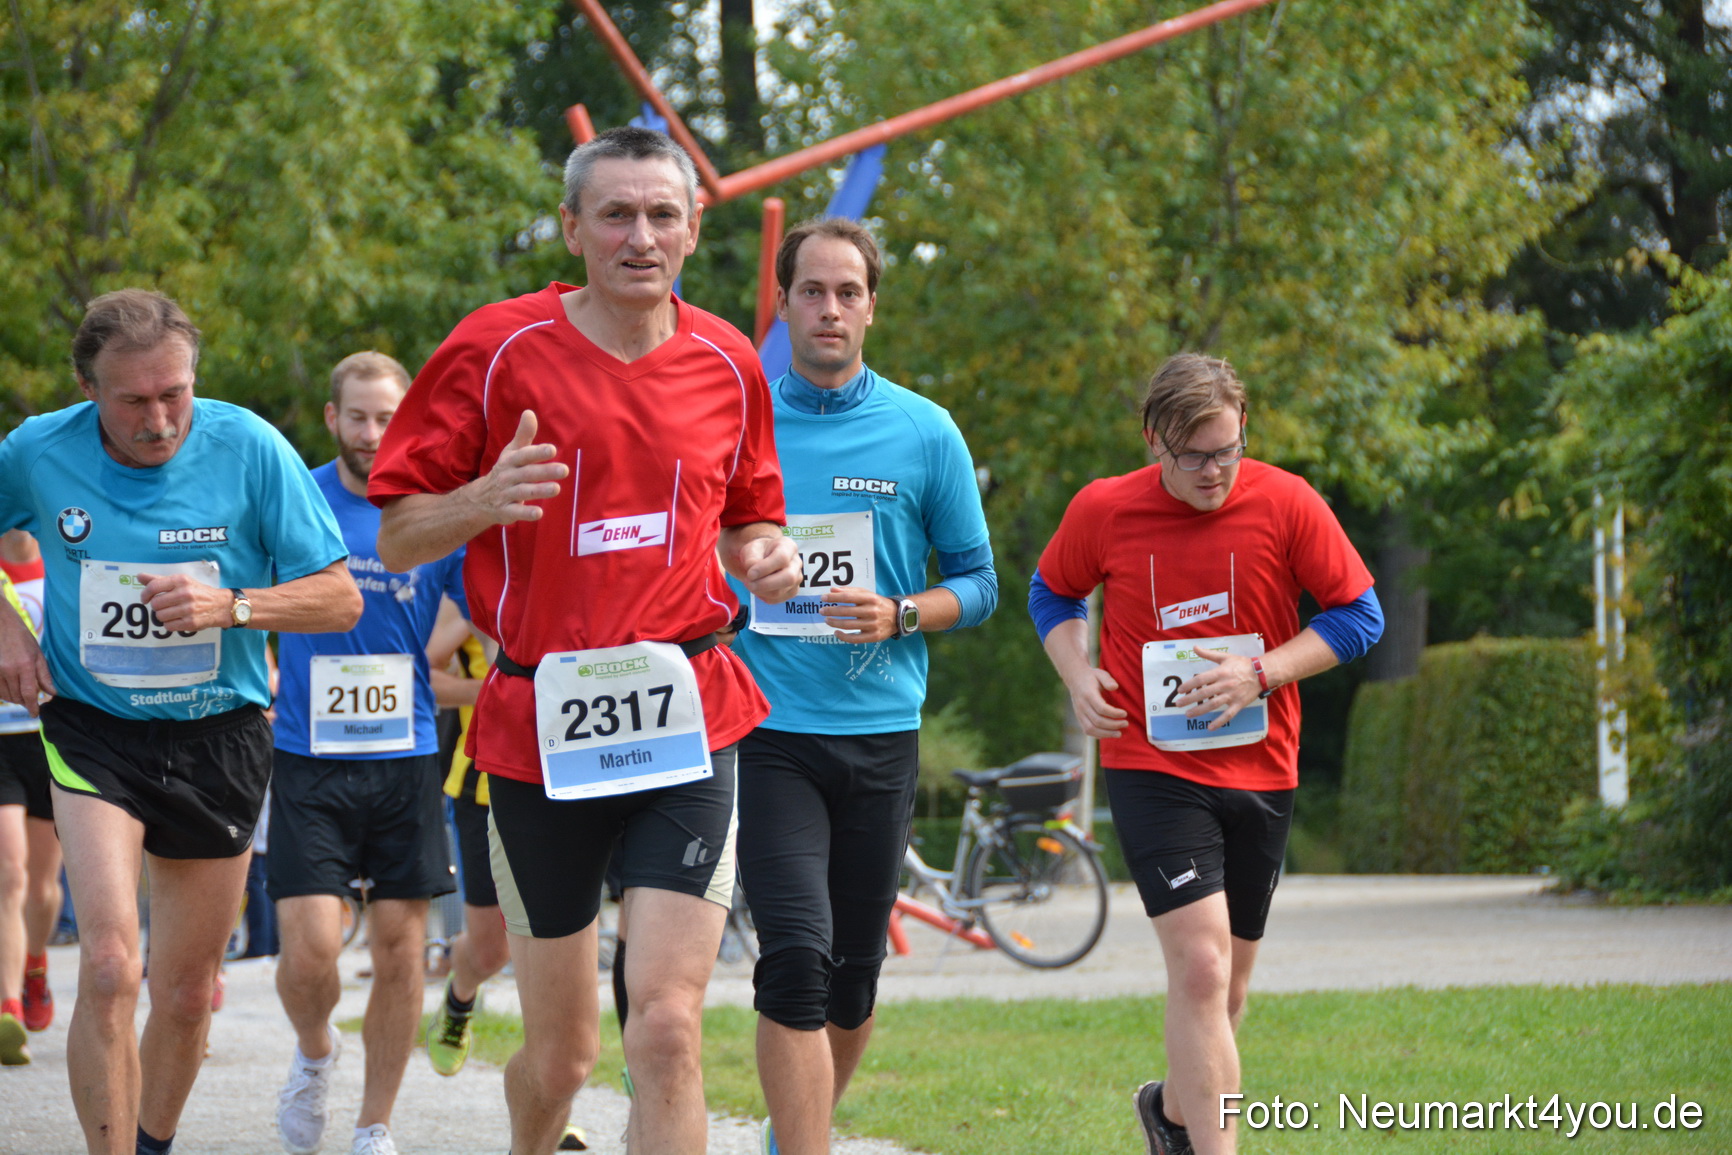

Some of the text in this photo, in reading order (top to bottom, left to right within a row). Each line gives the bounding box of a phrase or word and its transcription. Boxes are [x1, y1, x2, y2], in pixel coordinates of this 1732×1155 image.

[832, 476, 898, 496] BOCK
[159, 526, 228, 544] BOCK
[602, 525, 641, 542] DEHN
[792, 525, 835, 536] BOCK
[1179, 603, 1209, 619] DEHN
[594, 656, 649, 675] BOCK
[130, 688, 199, 706] Stadtlauf
[327, 684, 397, 714] 2105
[561, 684, 674, 742] 2317
[344, 724, 383, 735] Michael
[548, 739, 555, 747] D
[599, 749, 653, 769] Martin
